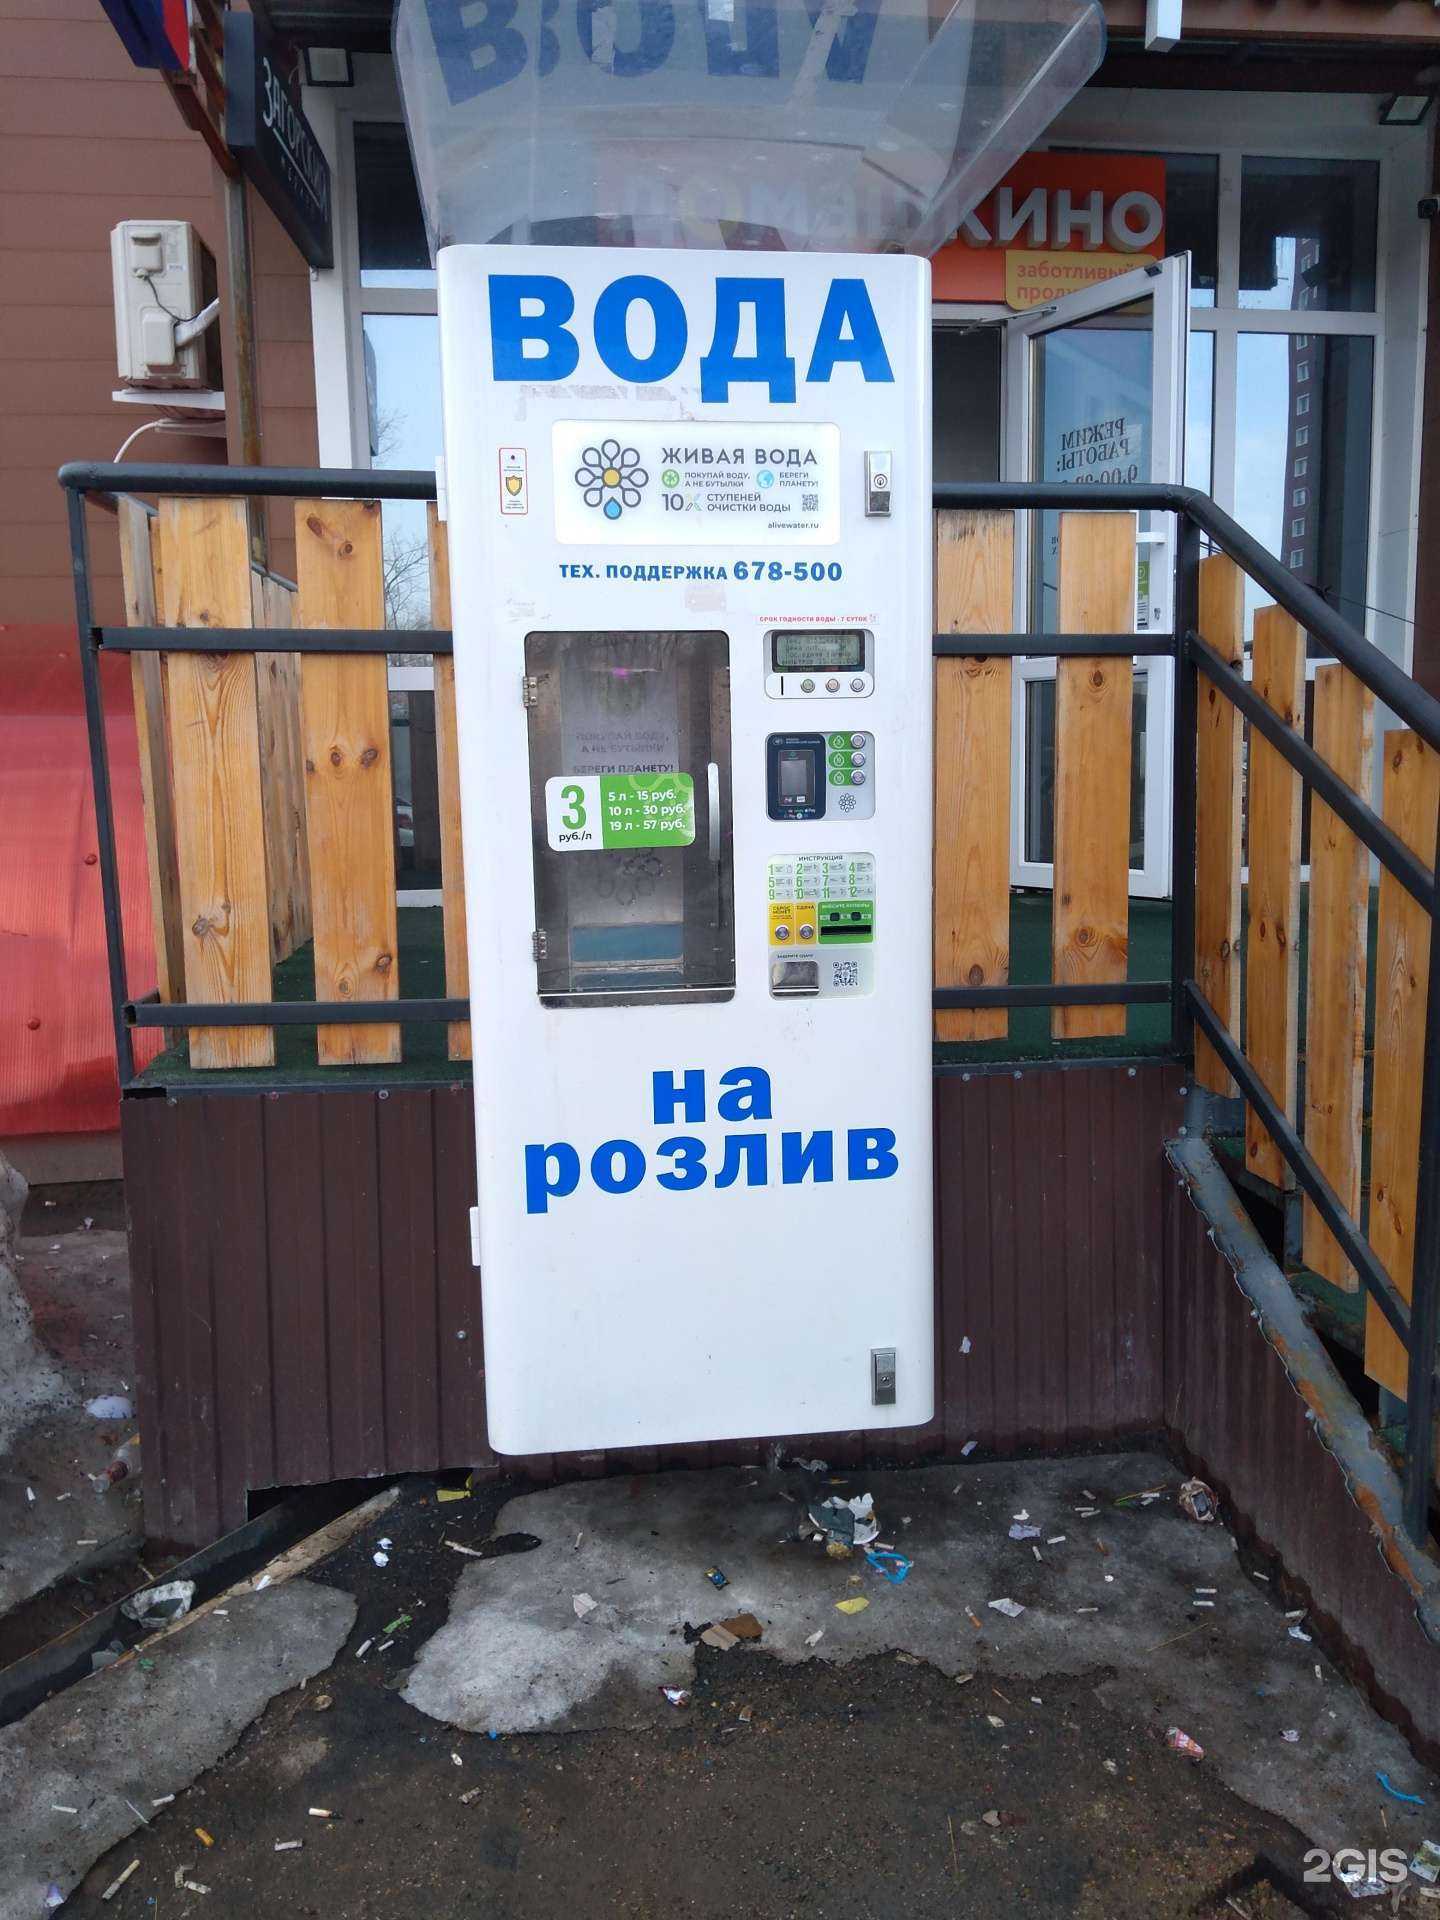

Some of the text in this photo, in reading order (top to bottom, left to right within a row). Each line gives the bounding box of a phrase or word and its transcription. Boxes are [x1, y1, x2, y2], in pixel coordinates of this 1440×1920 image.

[489, 274, 895, 403] ВОДА
[661, 447, 818, 468] ЖИВАЯ ВОДА
[684, 471, 725, 479] ПОКУПАЙ
[707, 492, 762, 502] СТУПЕНЕЙ
[707, 503, 792, 513] ОЧИСТКИ ВОДЫ
[767, 522, 820, 530] alivewater.ru
[558, 560, 844, 582] ТЕХ. ПОДДЕРЖКА 678-500
[618, 764, 674, 773] ПЛАНЕТУ!
[608, 792, 616, 801] 5
[619, 792, 627, 801] л
[637, 790, 649, 801] 15
[651, 789, 677, 803] руб.
[560, 784, 587, 830] 3
[609, 806, 622, 817] 10
[624, 806, 633, 816] л
[643, 805, 658, 816] 30
[661, 803, 686, 817] руб.
[610, 821, 622, 831] 19
[624, 821, 633, 831] л
[643, 819, 656, 830] 57
[660, 818, 686, 832] руб.
[558, 831, 592, 843] руб./л
[769, 864, 774, 875] 1
[796, 863, 803, 875] 2
[822, 863, 829, 874] 3
[848, 862, 855, 873] 4
[768, 877, 775, 888] 5
[796, 876, 803, 887] 6
[822, 875, 829, 886] 7
[848, 874, 855, 885] 8
[794, 888, 804, 899] 10
[822, 887, 830, 898] 11
[653, 1066, 772, 1125] на
[525, 1127, 899, 1214] розлив
